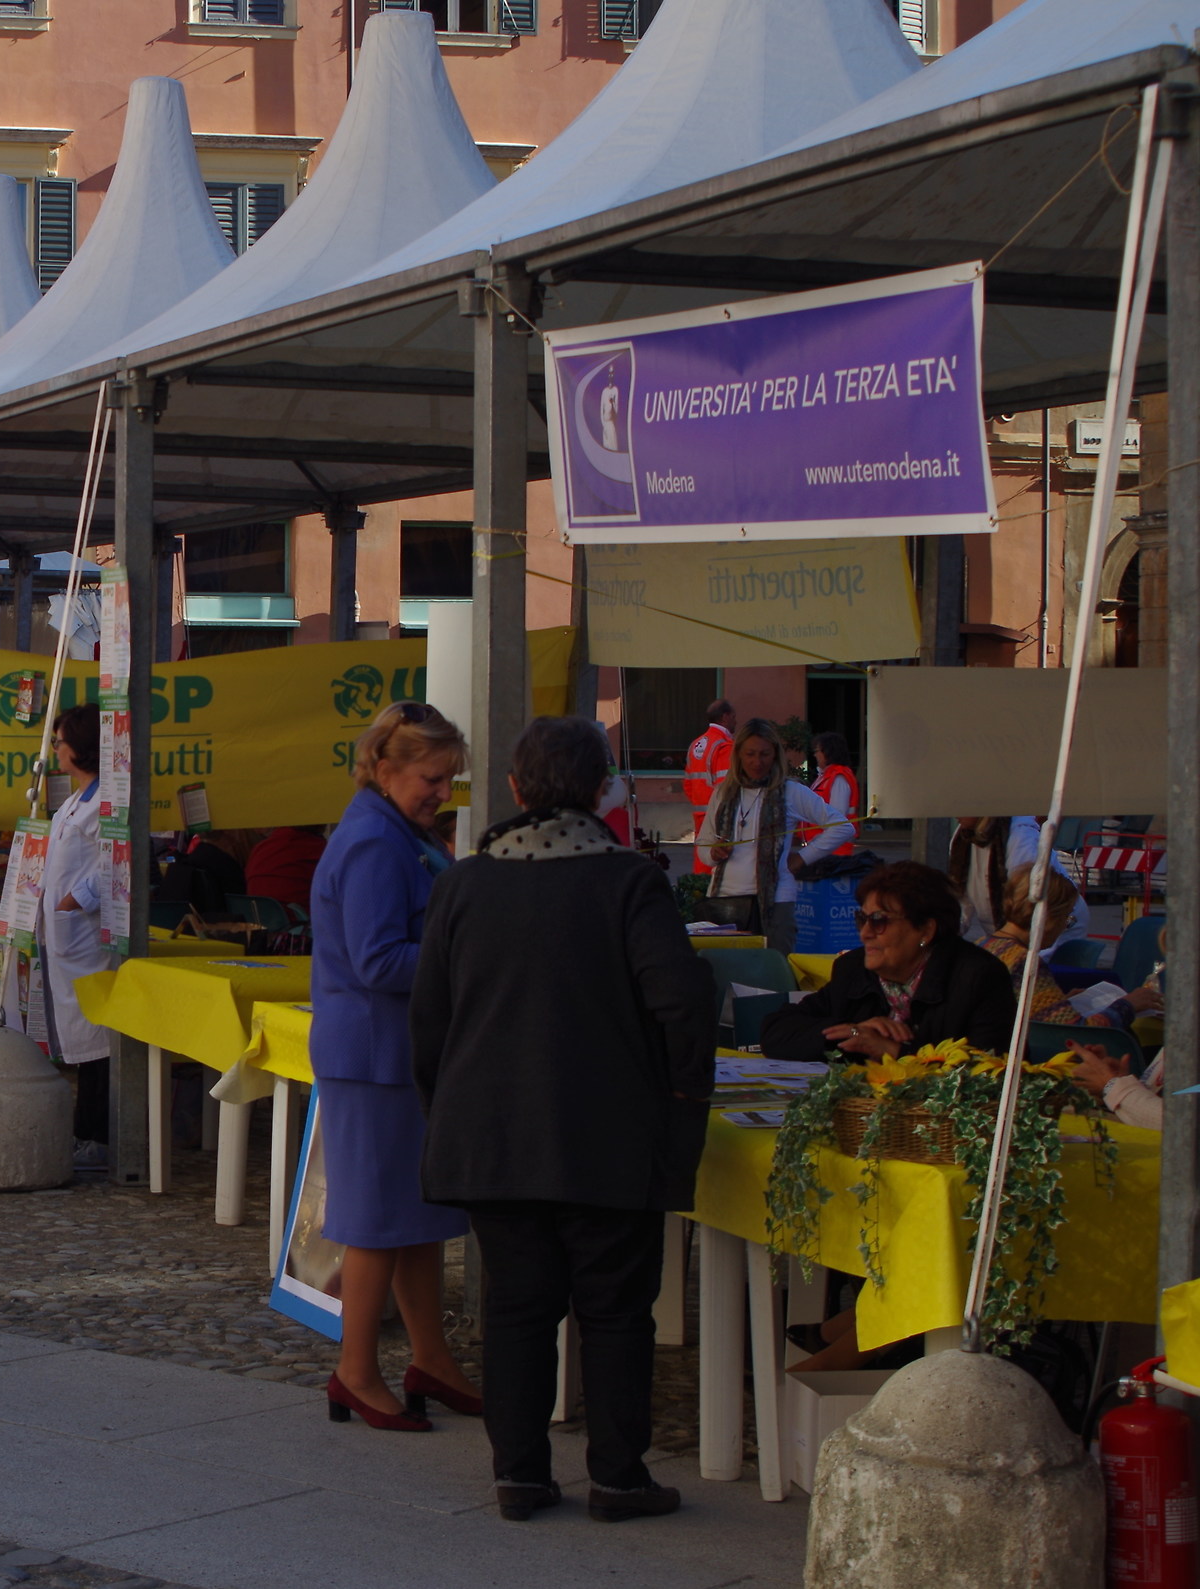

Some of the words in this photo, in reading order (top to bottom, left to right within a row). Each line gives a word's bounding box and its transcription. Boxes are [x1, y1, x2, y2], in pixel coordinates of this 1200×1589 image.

[644, 381, 757, 423] UNIVERSITA'
[760, 376, 798, 412] PER
[802, 373, 827, 408] LA
[834, 363, 900, 404] TERZA
[646, 469, 695, 495] Modena
[805, 450, 961, 486] www.utemodena.it
